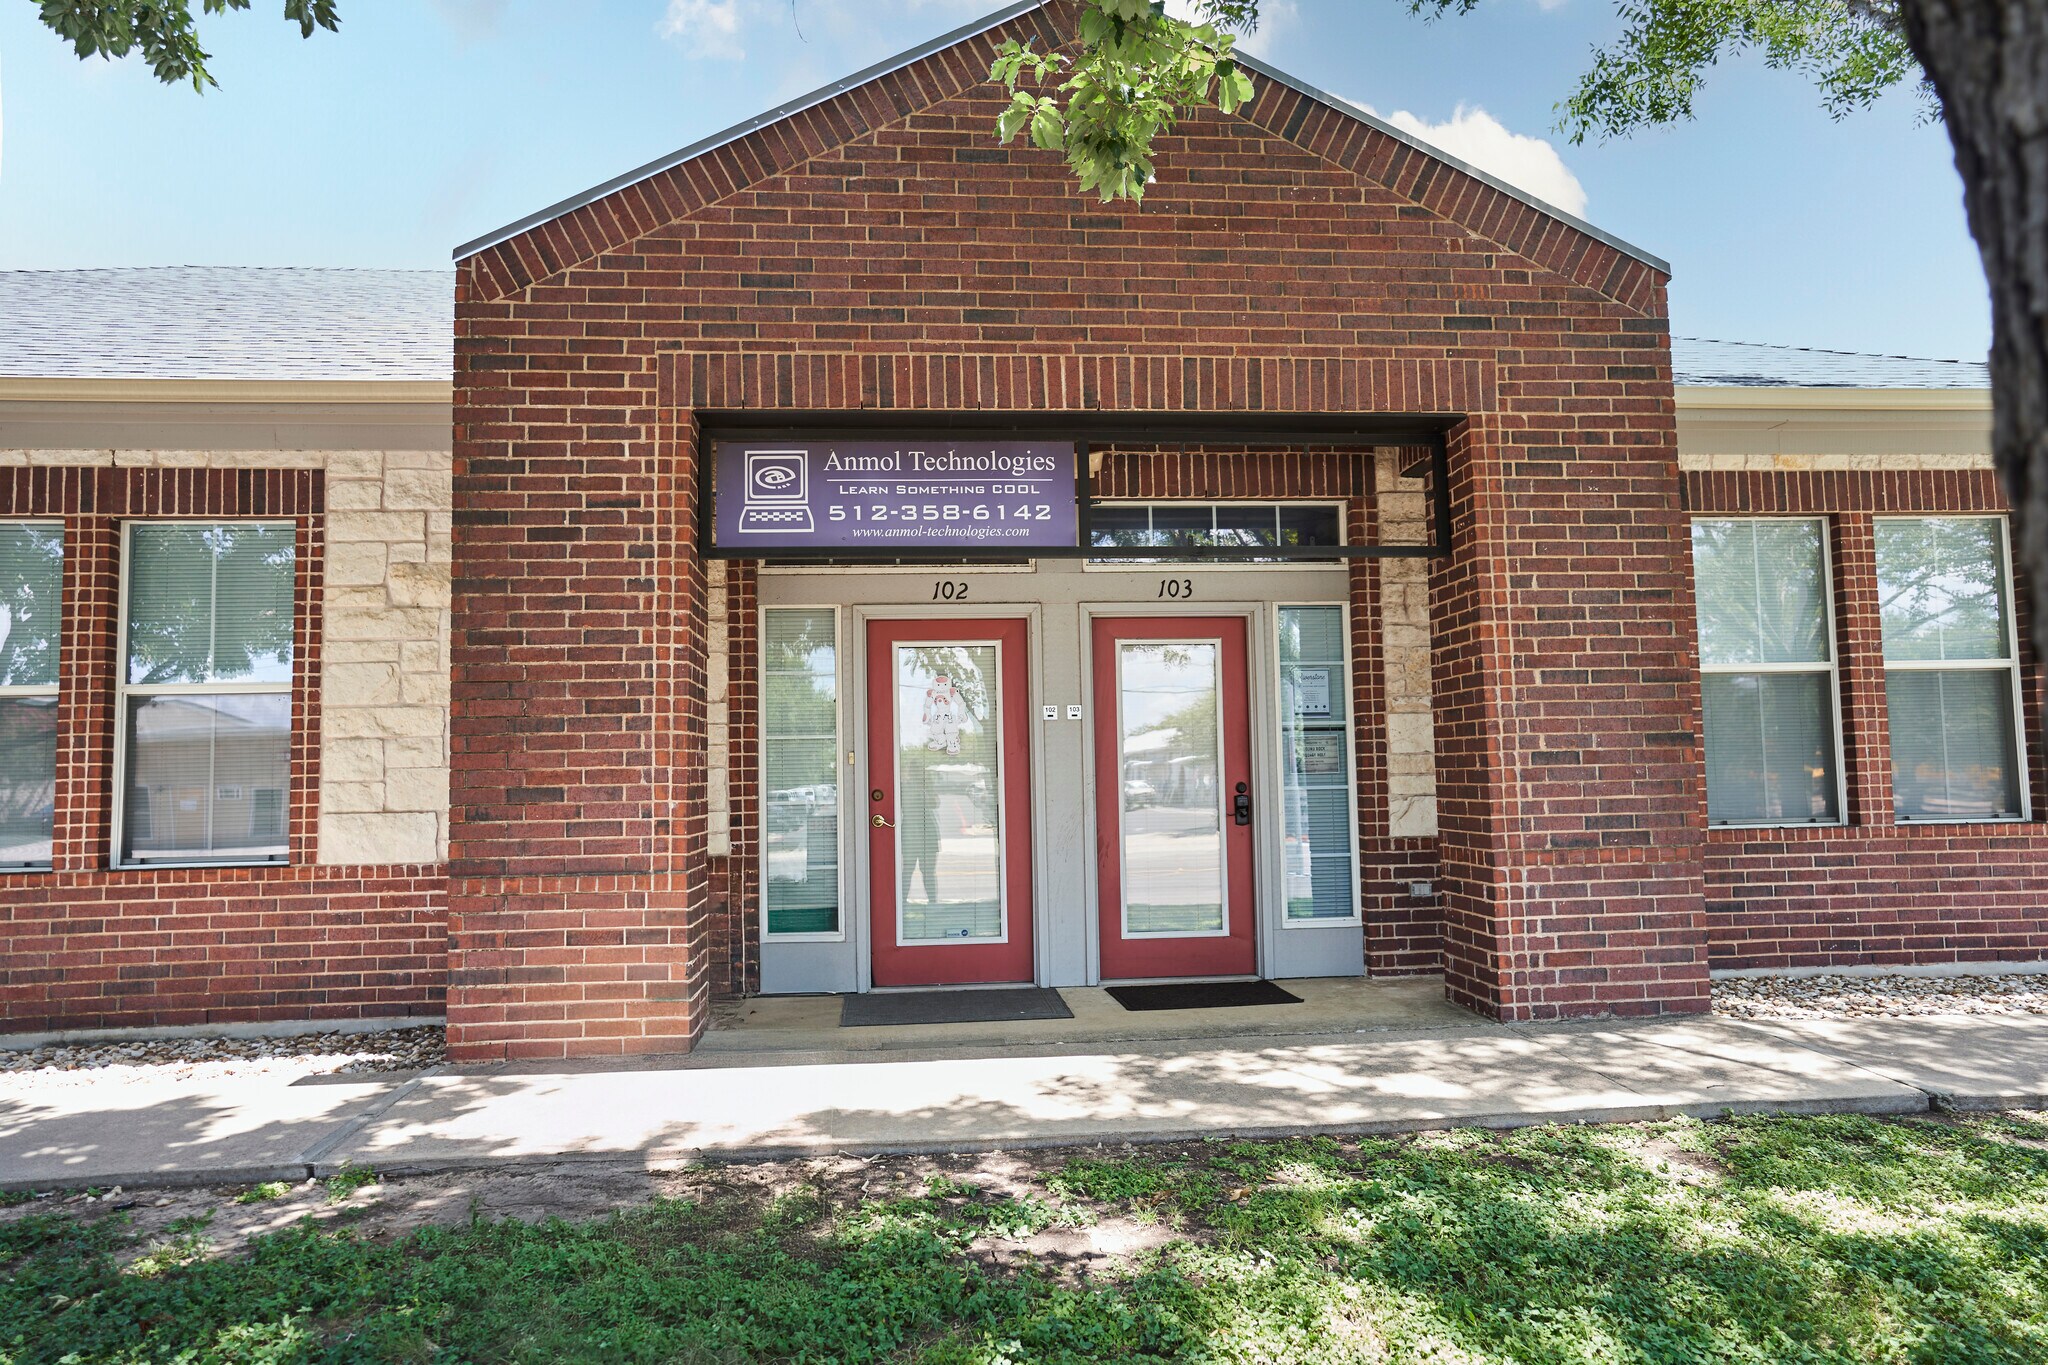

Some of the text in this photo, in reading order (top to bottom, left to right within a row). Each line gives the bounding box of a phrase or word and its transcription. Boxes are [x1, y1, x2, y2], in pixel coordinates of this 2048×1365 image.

[823, 450, 1056, 476] Anmol Technologies
[839, 484, 1040, 495] LEARN SOMETHING COOL
[829, 504, 1051, 521] 512-358-6142
[852, 525, 1030, 539] www.anmol-technologies.com
[932, 581, 969, 600] 102
[1158, 579, 1193, 598] 103
